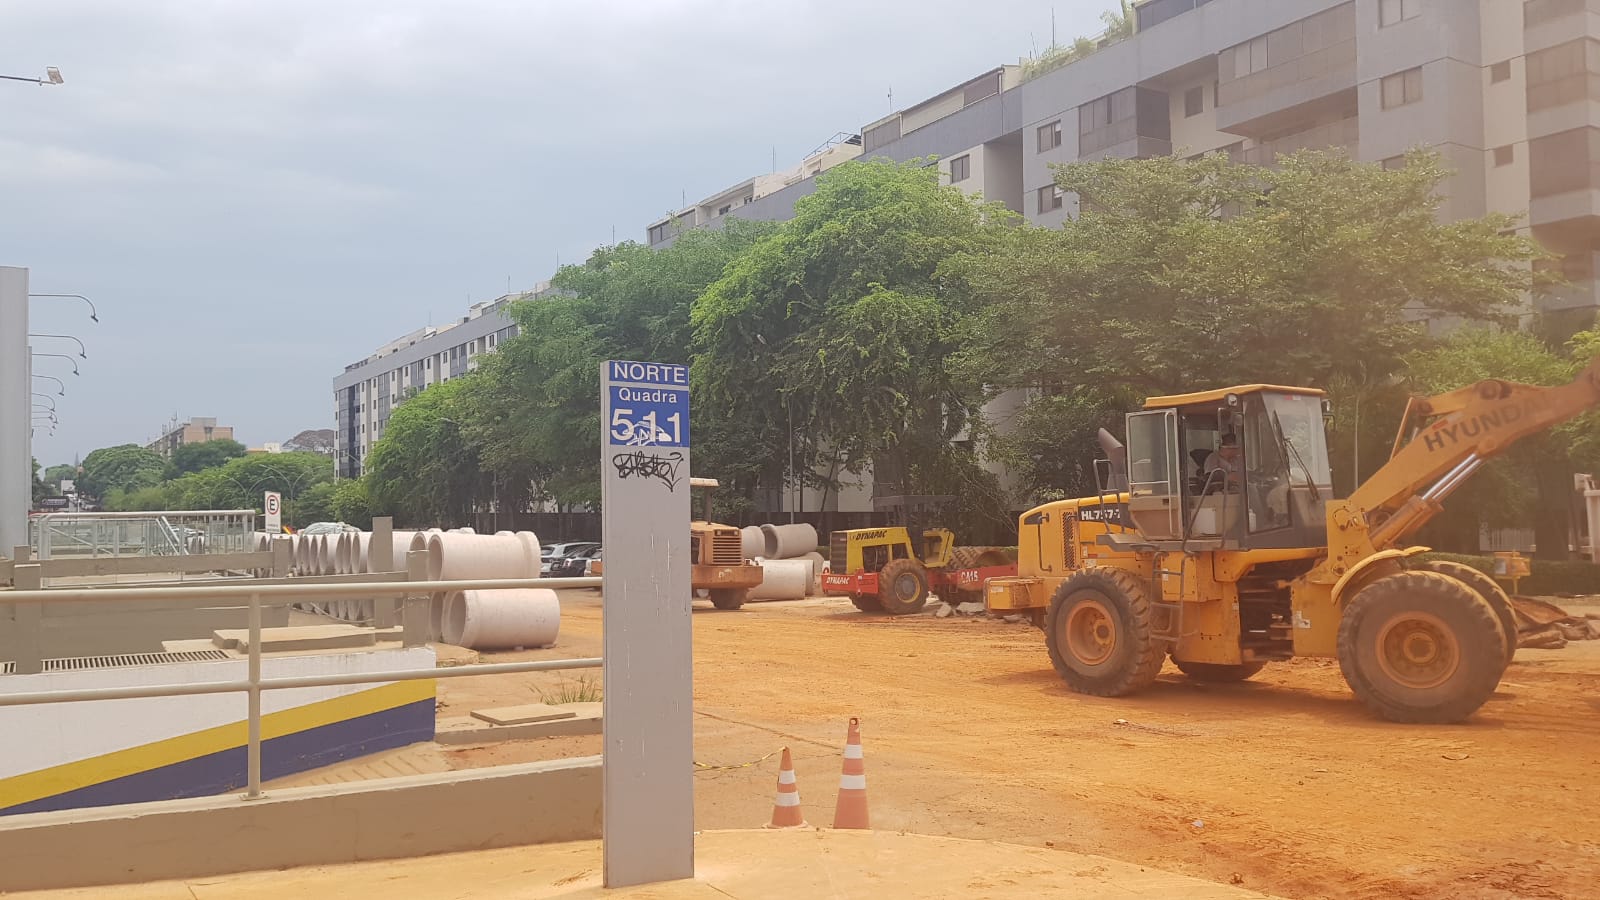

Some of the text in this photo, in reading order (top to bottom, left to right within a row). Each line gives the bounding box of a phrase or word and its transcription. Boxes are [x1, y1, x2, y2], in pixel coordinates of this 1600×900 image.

[614, 362, 686, 383] NORTE
[618, 387, 678, 403] Quadra
[610, 408, 681, 443] 511
[269, 499, 275, 511] E
[855, 530, 888, 541] DYNAPAC
[825, 576, 850, 585] DYNAPAC
